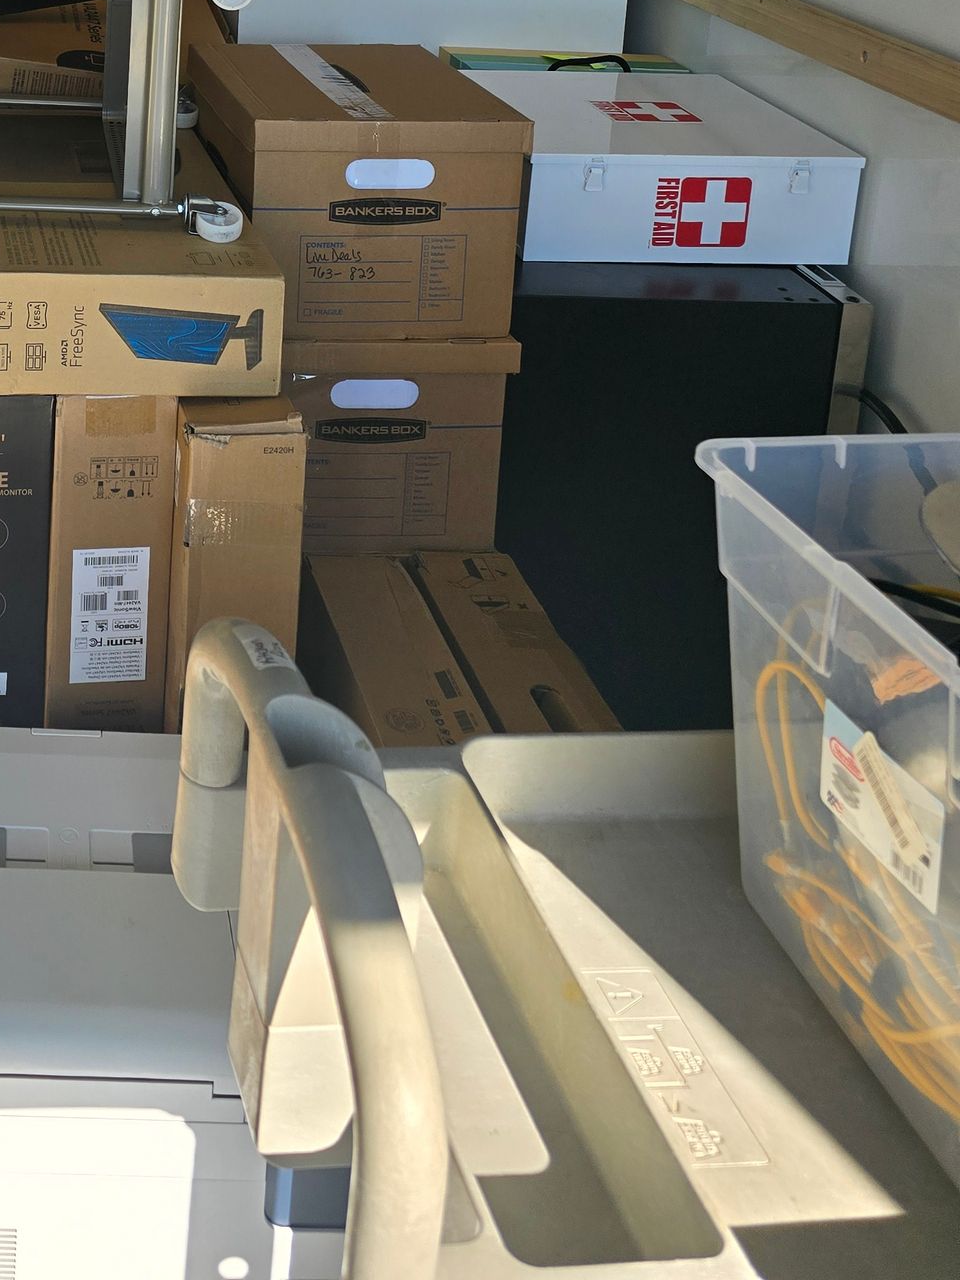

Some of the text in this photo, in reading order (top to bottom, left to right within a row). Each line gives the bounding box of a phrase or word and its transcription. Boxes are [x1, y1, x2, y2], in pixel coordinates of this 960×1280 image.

[335, 206, 436, 217] BANKERS BOX
[651, 178, 681, 247] FIRST AID
[331, 248, 362, 263] Deals
[349, 266, 376, 281] 823
[7, 301, 13, 310] Hz
[0, 310, 6, 321] 75
[70, 305, 88, 368] FreeSync
[321, 425, 421, 436] BANKERS BOX
[263, 446, 295, 455] E2420H
[106, 637, 143, 646] HDMI
